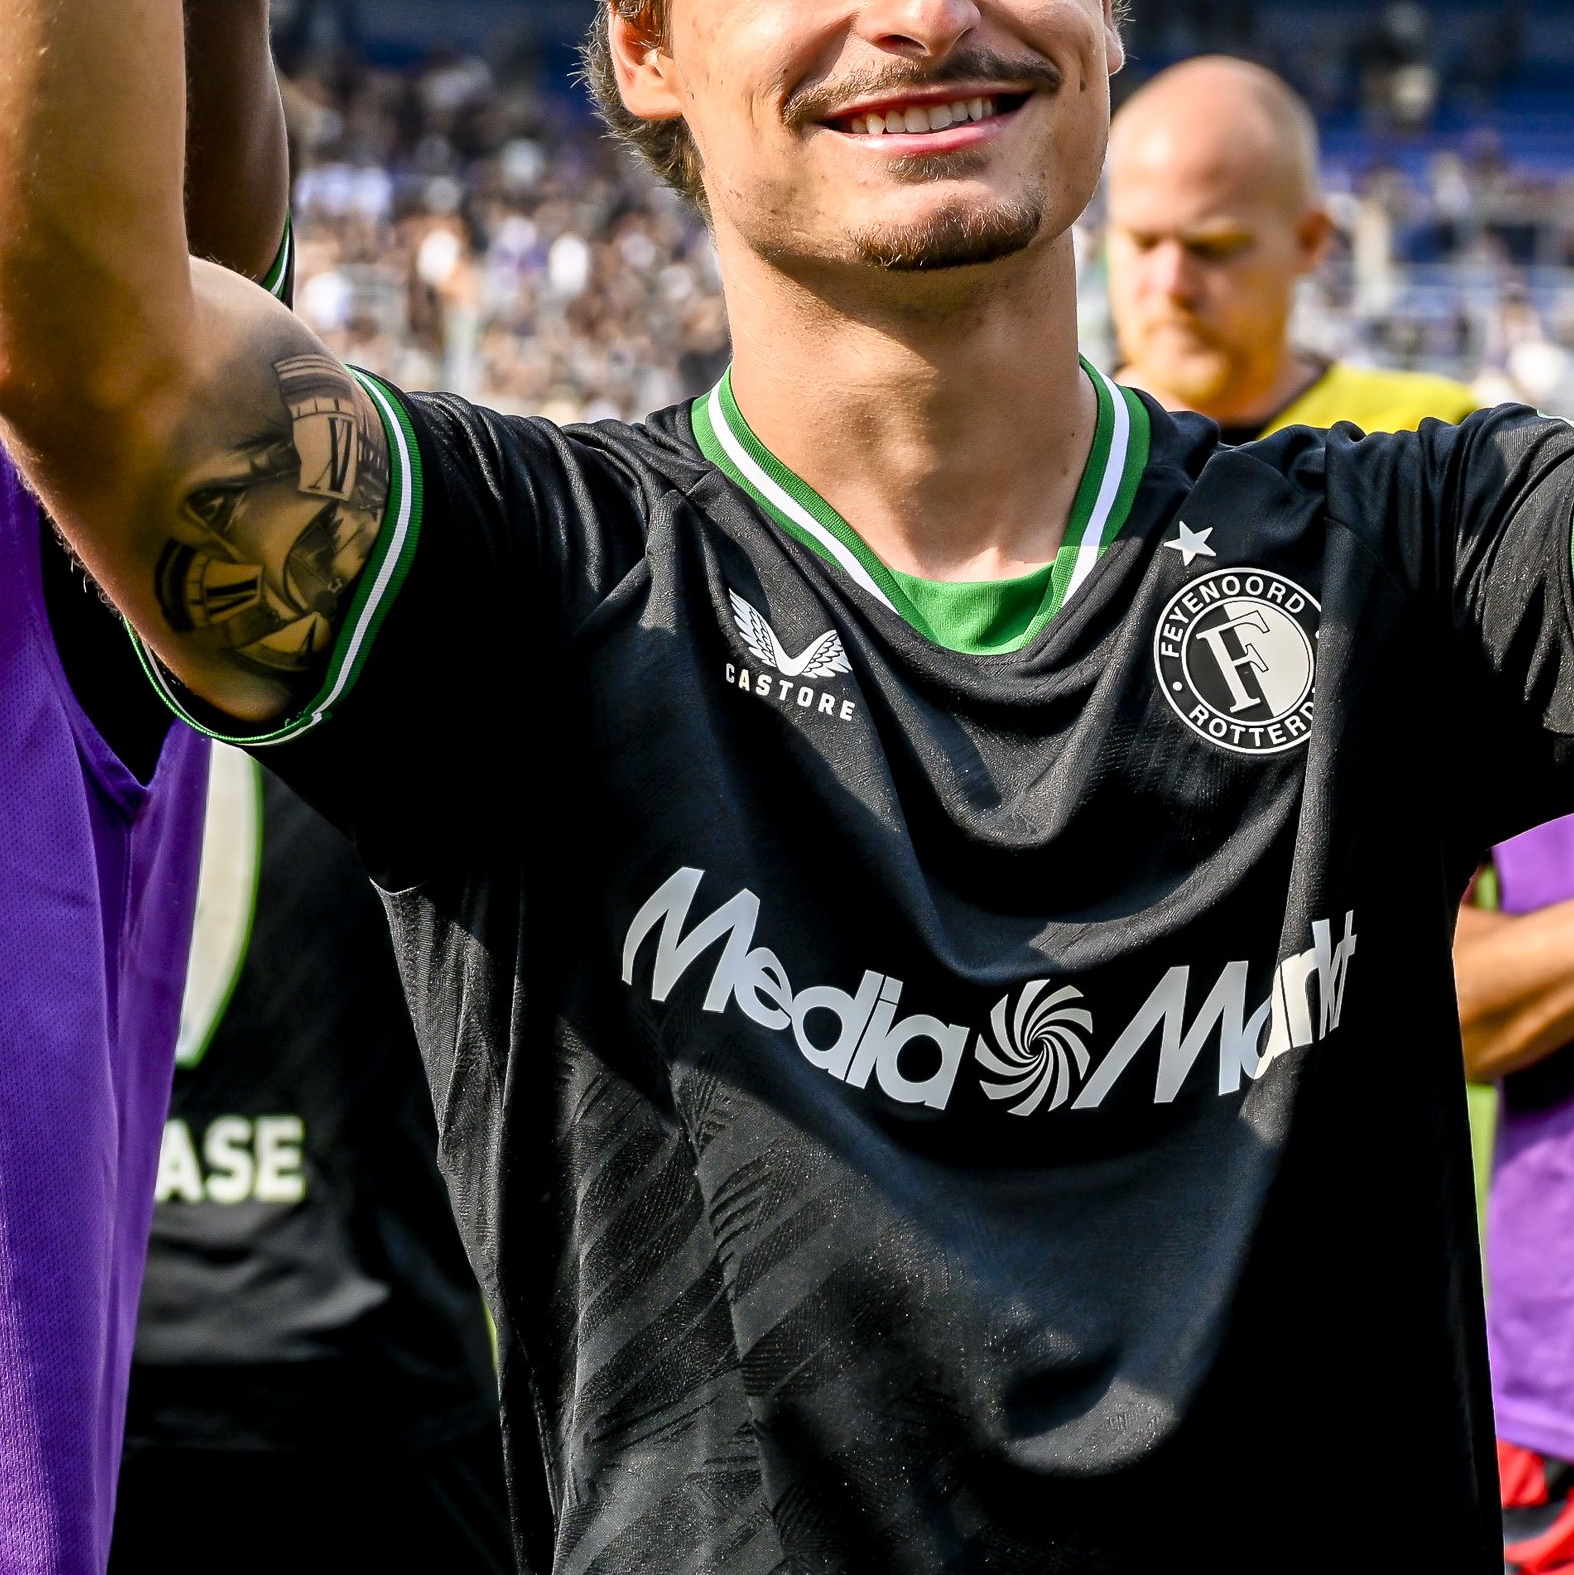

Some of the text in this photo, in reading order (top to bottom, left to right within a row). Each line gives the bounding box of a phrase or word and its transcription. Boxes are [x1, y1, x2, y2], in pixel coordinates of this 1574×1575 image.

[1160, 575, 1306, 658] FEYENOORD
[1195, 609, 1271, 714] F
[725, 662, 856, 722] CASTORE
[621, 866, 1358, 1112] Media Markt
